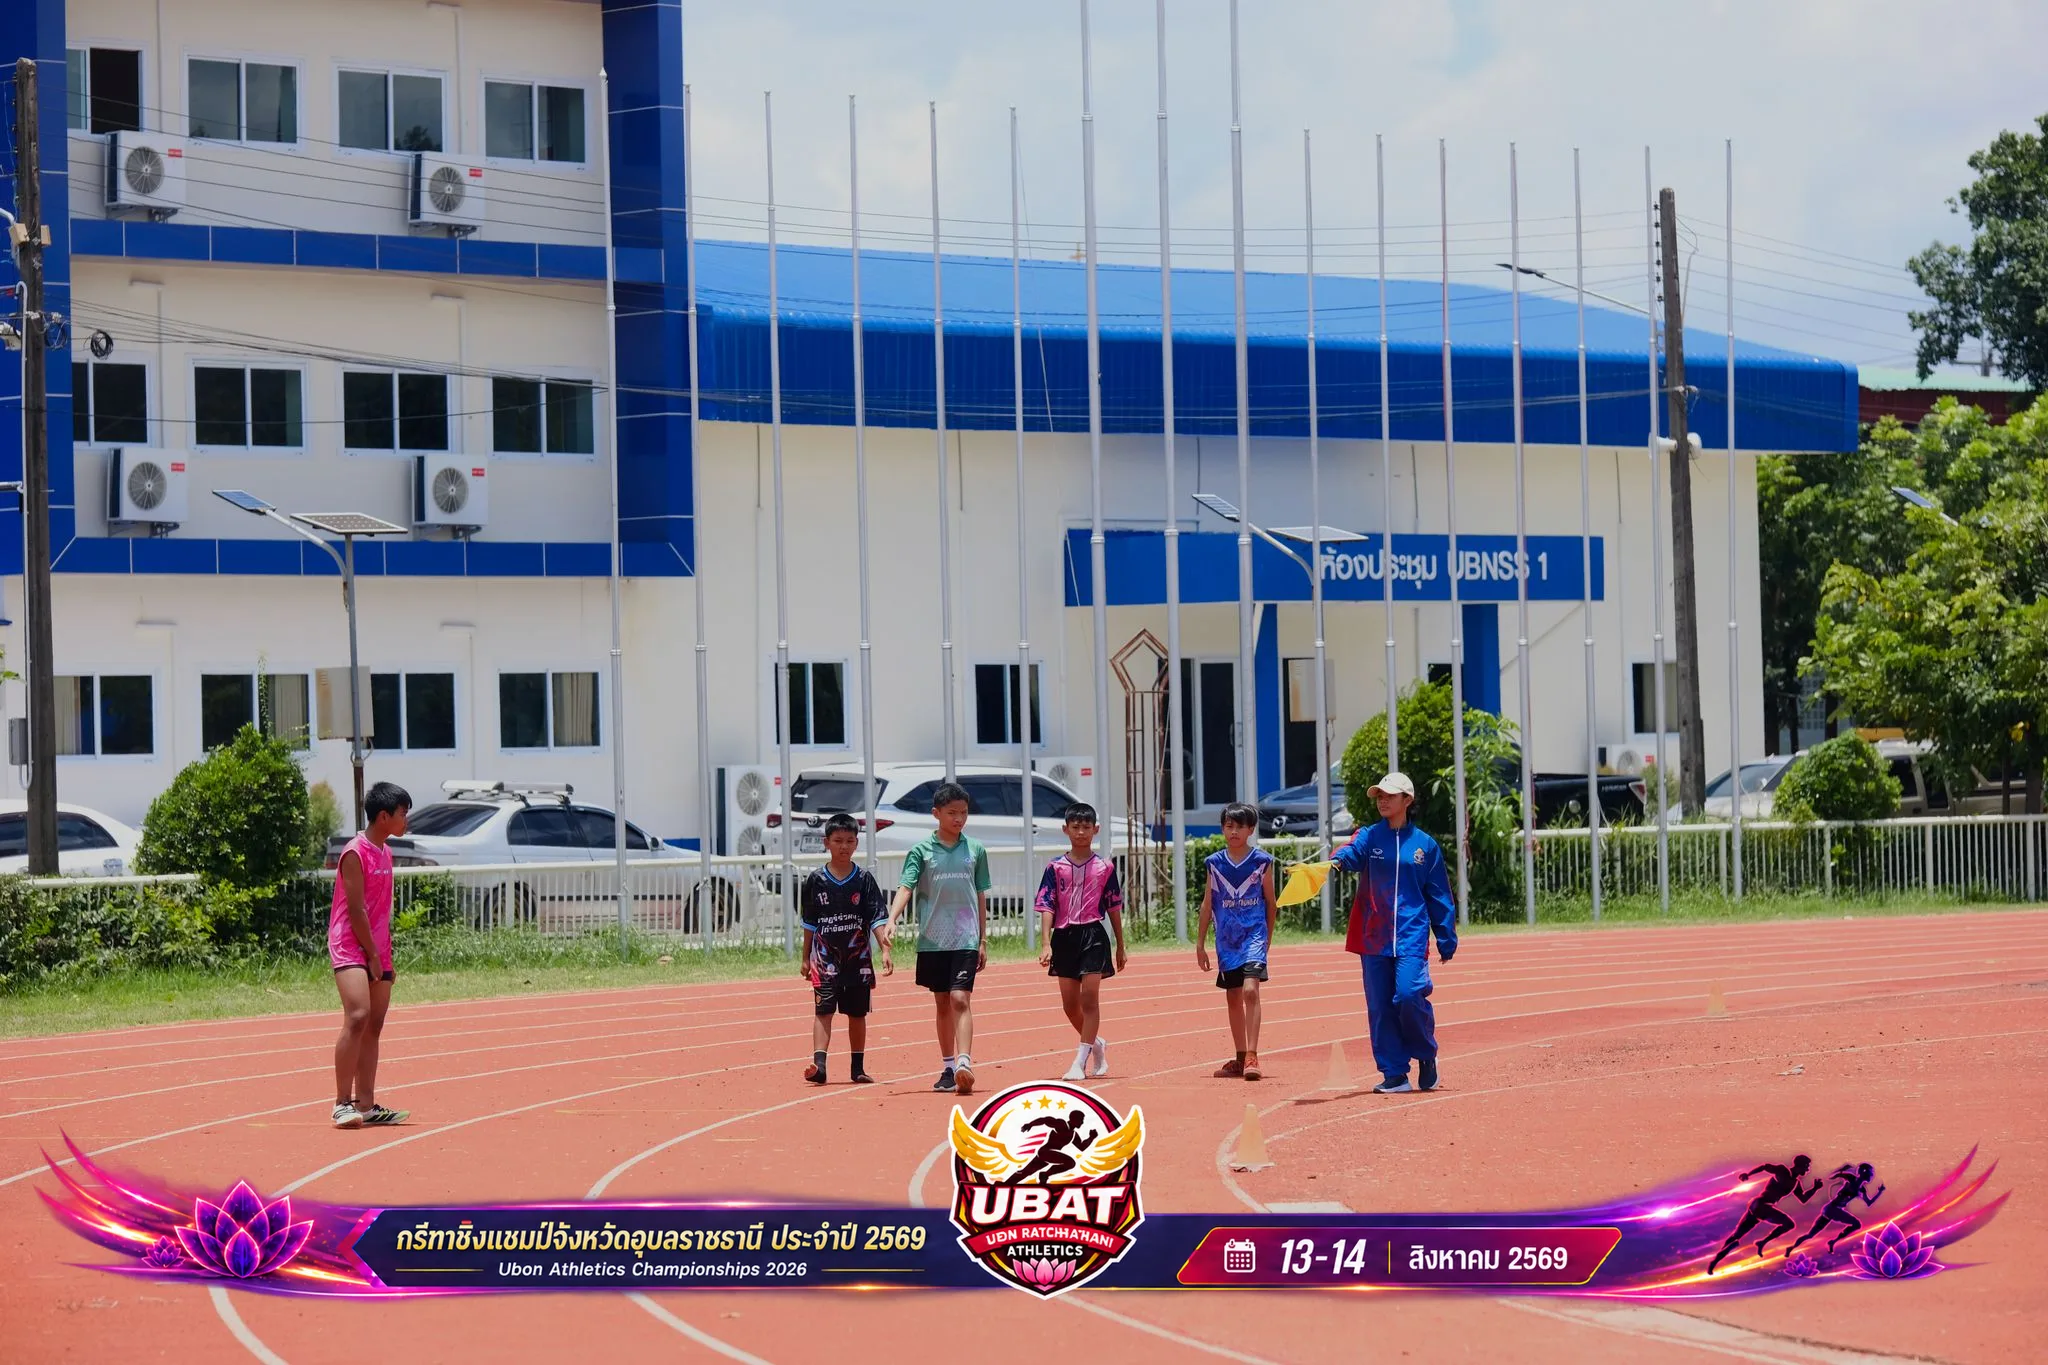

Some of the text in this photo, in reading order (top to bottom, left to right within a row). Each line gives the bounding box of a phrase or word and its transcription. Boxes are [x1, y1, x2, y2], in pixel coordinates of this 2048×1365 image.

[1320, 546, 1548, 590] ห้องประชุม UBNSS 1
[817, 891, 830, 905] 12
